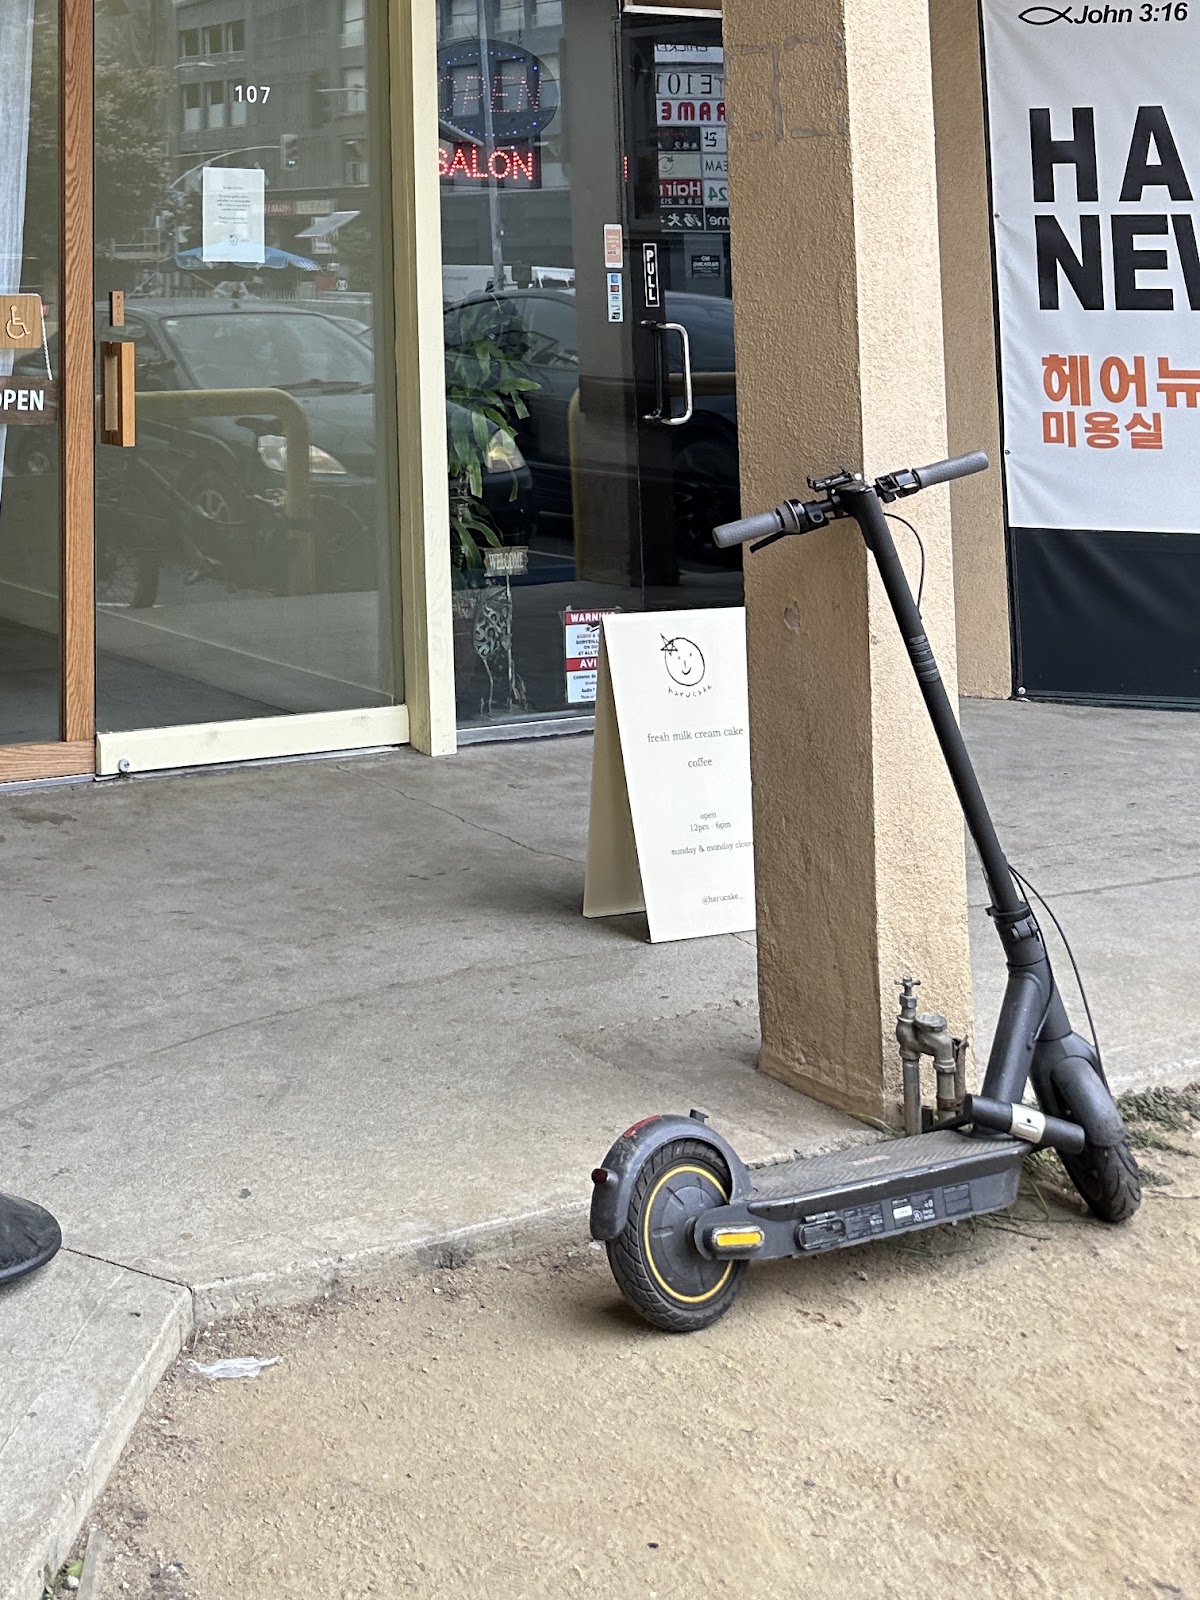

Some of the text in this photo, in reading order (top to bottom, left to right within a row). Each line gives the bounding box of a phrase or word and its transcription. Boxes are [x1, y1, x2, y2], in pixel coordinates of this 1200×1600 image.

[1073, 2, 1188, 24] John 3:16
[234, 86, 271, 104] 107
[1028, 105, 1194, 203] HA
[439, 147, 534, 181] SALON
[646, 250, 656, 300] PULL
[1041, 353, 1200, 408] 헤어뉴
[1042, 412, 1164, 451] 미용실
[489, 552, 524, 570] WELCOME
[571, 612, 614, 623] WARNI
[647, 726, 744, 743] fresh milk cream cake
[687, 757, 713, 768] coffee
[700, 812, 717, 821] open
[690, 821, 731, 833] 12pm 6pm
[671, 847, 696, 855] sunday
[706, 842, 734, 851] monday
[735, 840, 754, 849] close
